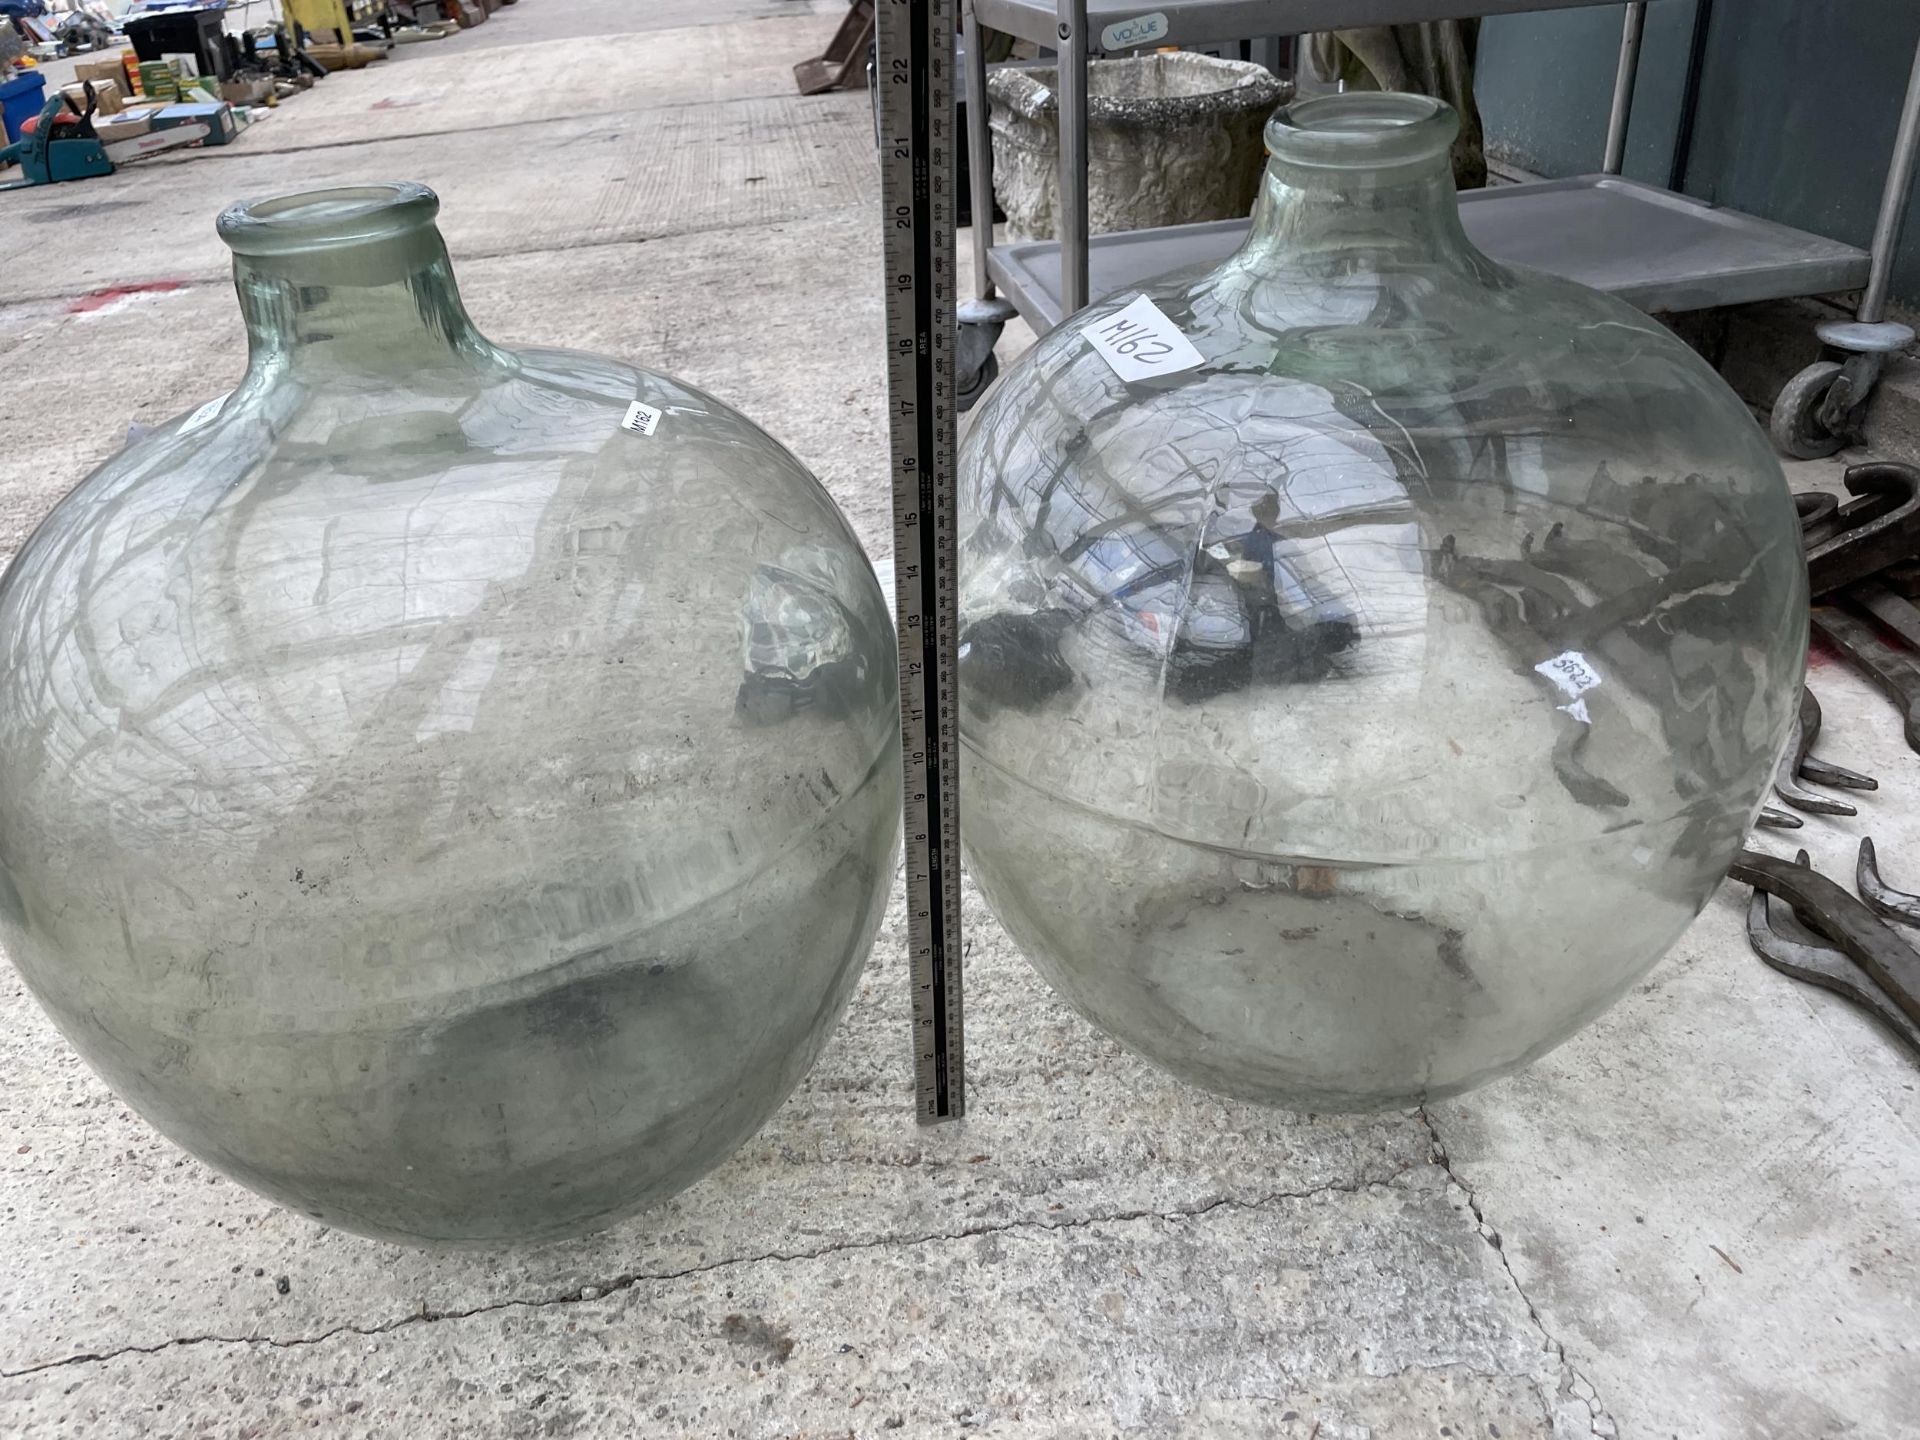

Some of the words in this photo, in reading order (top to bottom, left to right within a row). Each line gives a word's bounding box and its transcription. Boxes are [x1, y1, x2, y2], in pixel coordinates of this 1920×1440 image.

[893, 59, 908, 84] 22
[895, 138, 910, 158] 21
[897, 207, 911, 228] 20
[898, 275, 912, 292] 19
[900, 339, 913, 356] 18
[1099, 319, 1174, 364] M162
[901, 401, 914, 416] 17
[630, 410, 652, 434] M162
[903, 458, 916, 473] 16
[905, 513, 918, 527] 15
[907, 566, 919, 579] 14
[908, 615, 920, 627] 13
[910, 663, 922, 675] 12
[912, 710, 923, 721] 11
[913, 752, 925, 765] 10
